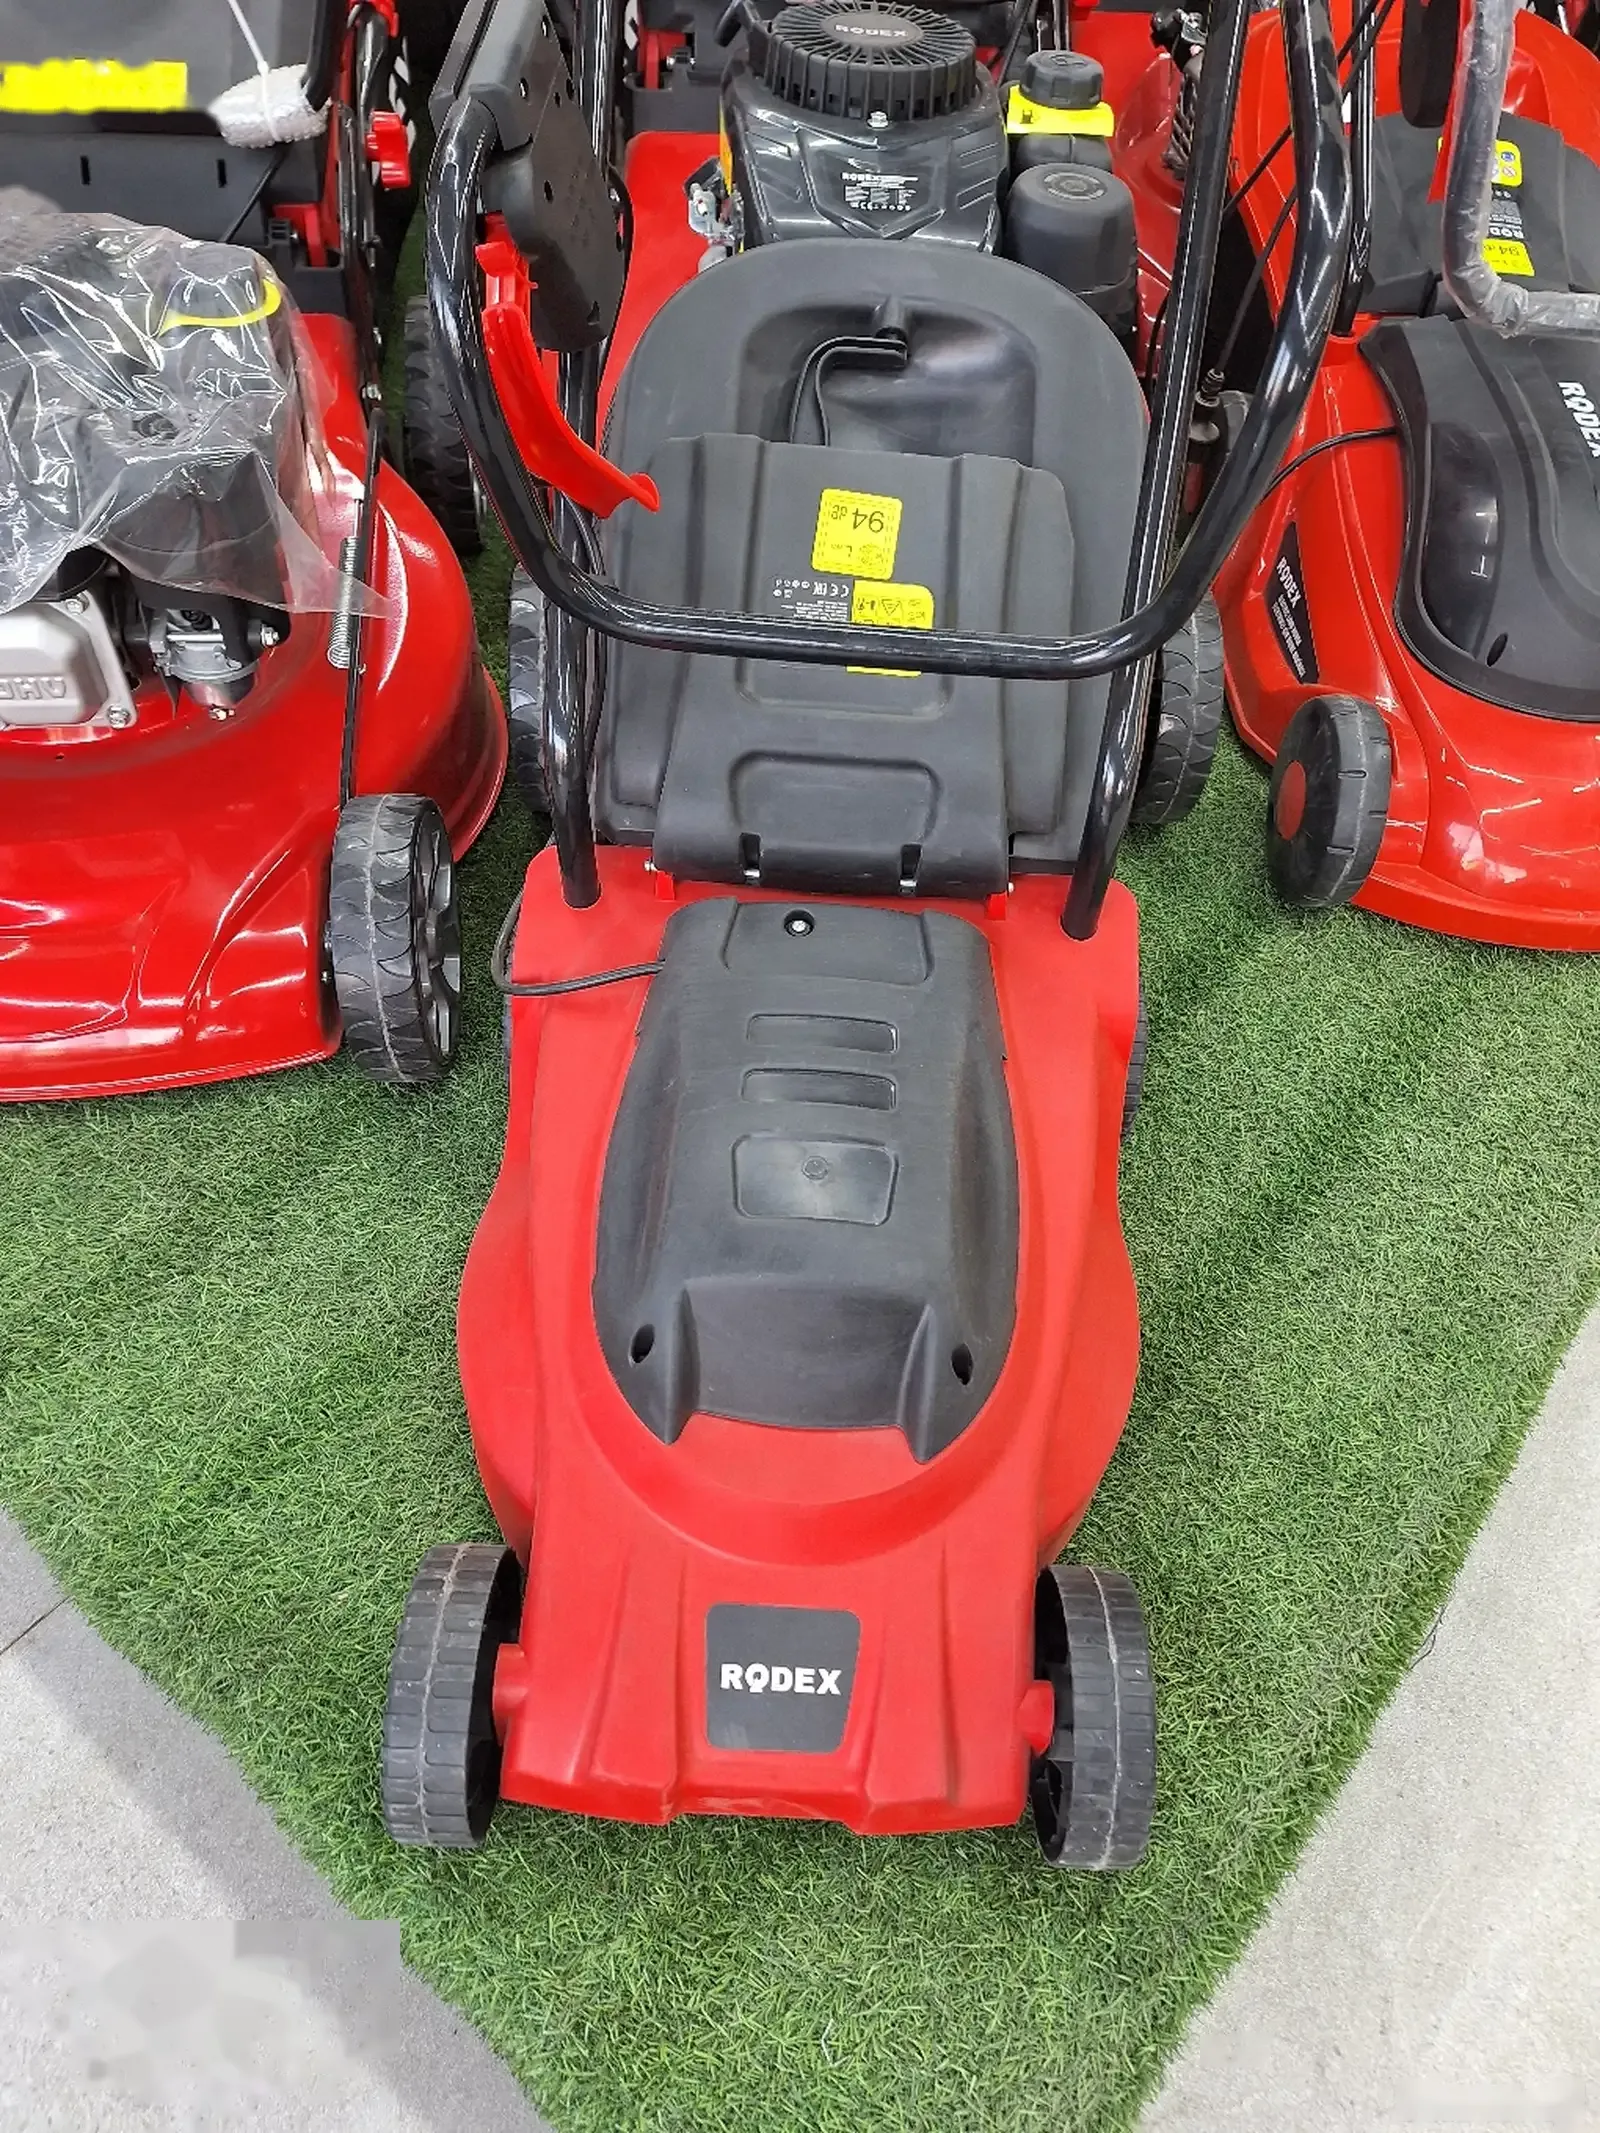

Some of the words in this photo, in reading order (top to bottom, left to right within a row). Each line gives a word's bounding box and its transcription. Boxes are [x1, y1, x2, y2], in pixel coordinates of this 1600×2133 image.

[835, 24, 909, 37] RODEX
[852, 508, 885, 533] 94
[1276, 556, 1301, 608] RODEX
[720, 1662, 842, 1695] RODEX
